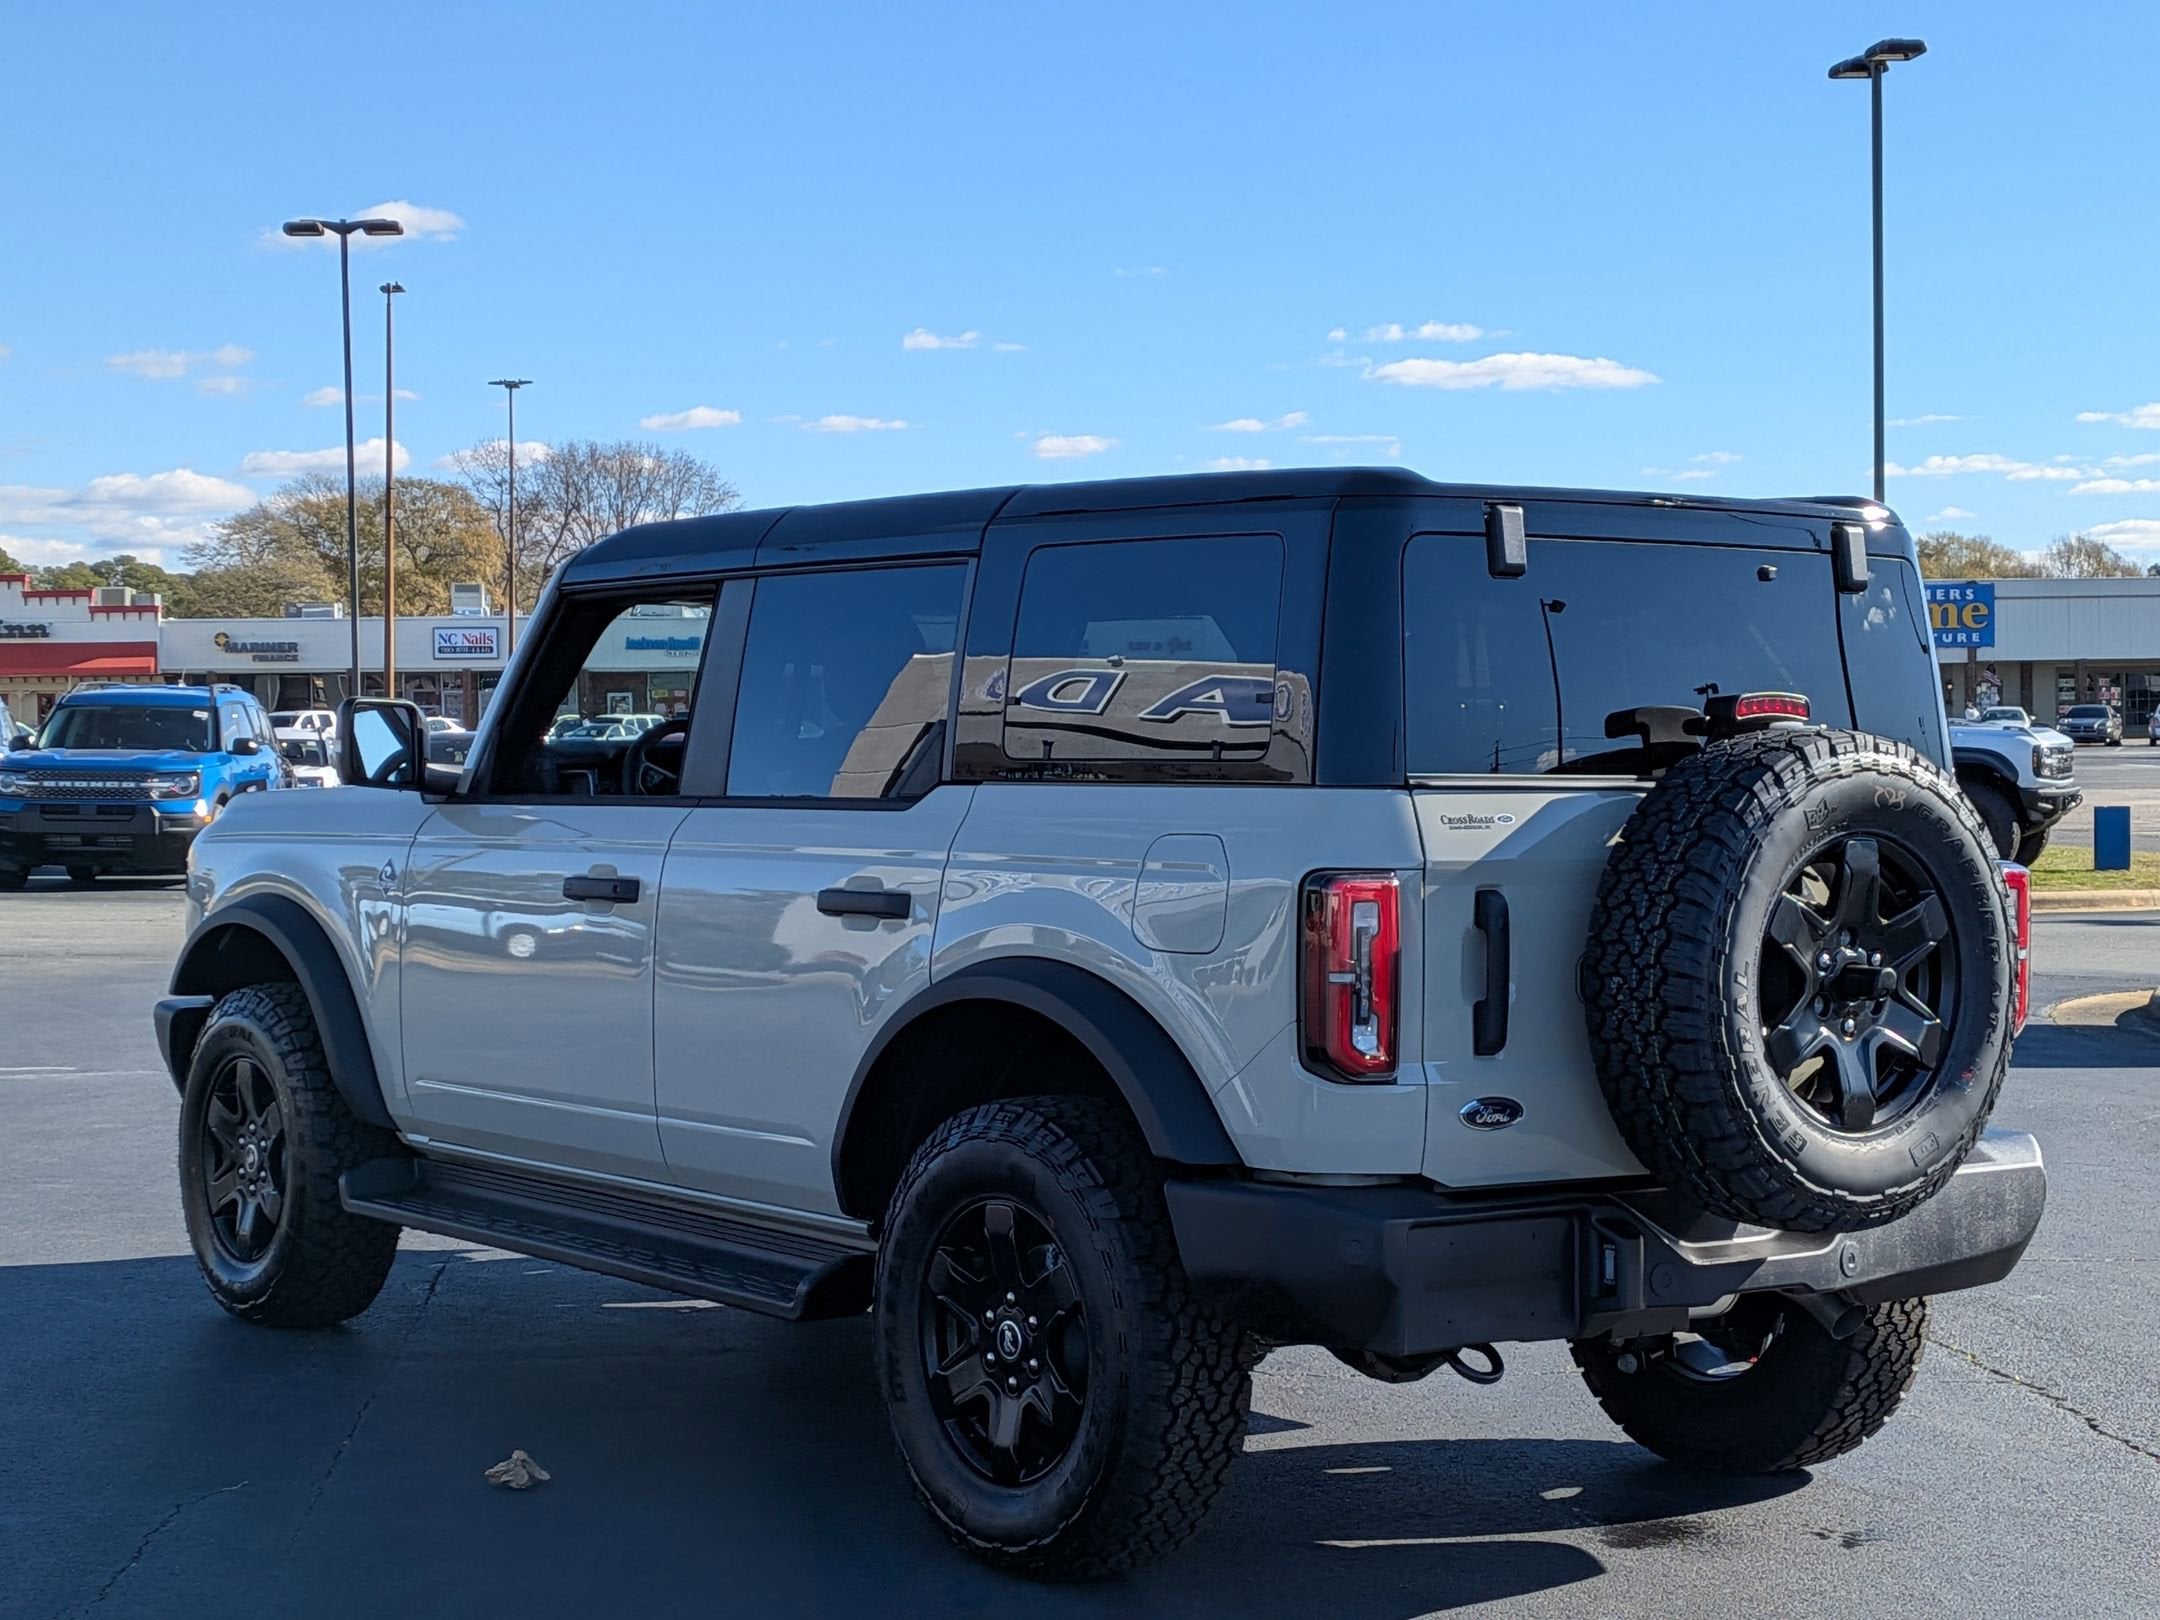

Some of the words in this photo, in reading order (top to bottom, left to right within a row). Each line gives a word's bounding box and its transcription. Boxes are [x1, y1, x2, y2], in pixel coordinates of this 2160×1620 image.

[438, 632, 458, 645] NC
[462, 632, 494, 645] Nails
[224, 642, 298, 653] MARINER
[1734, 960, 1809, 1156] GENERAL
